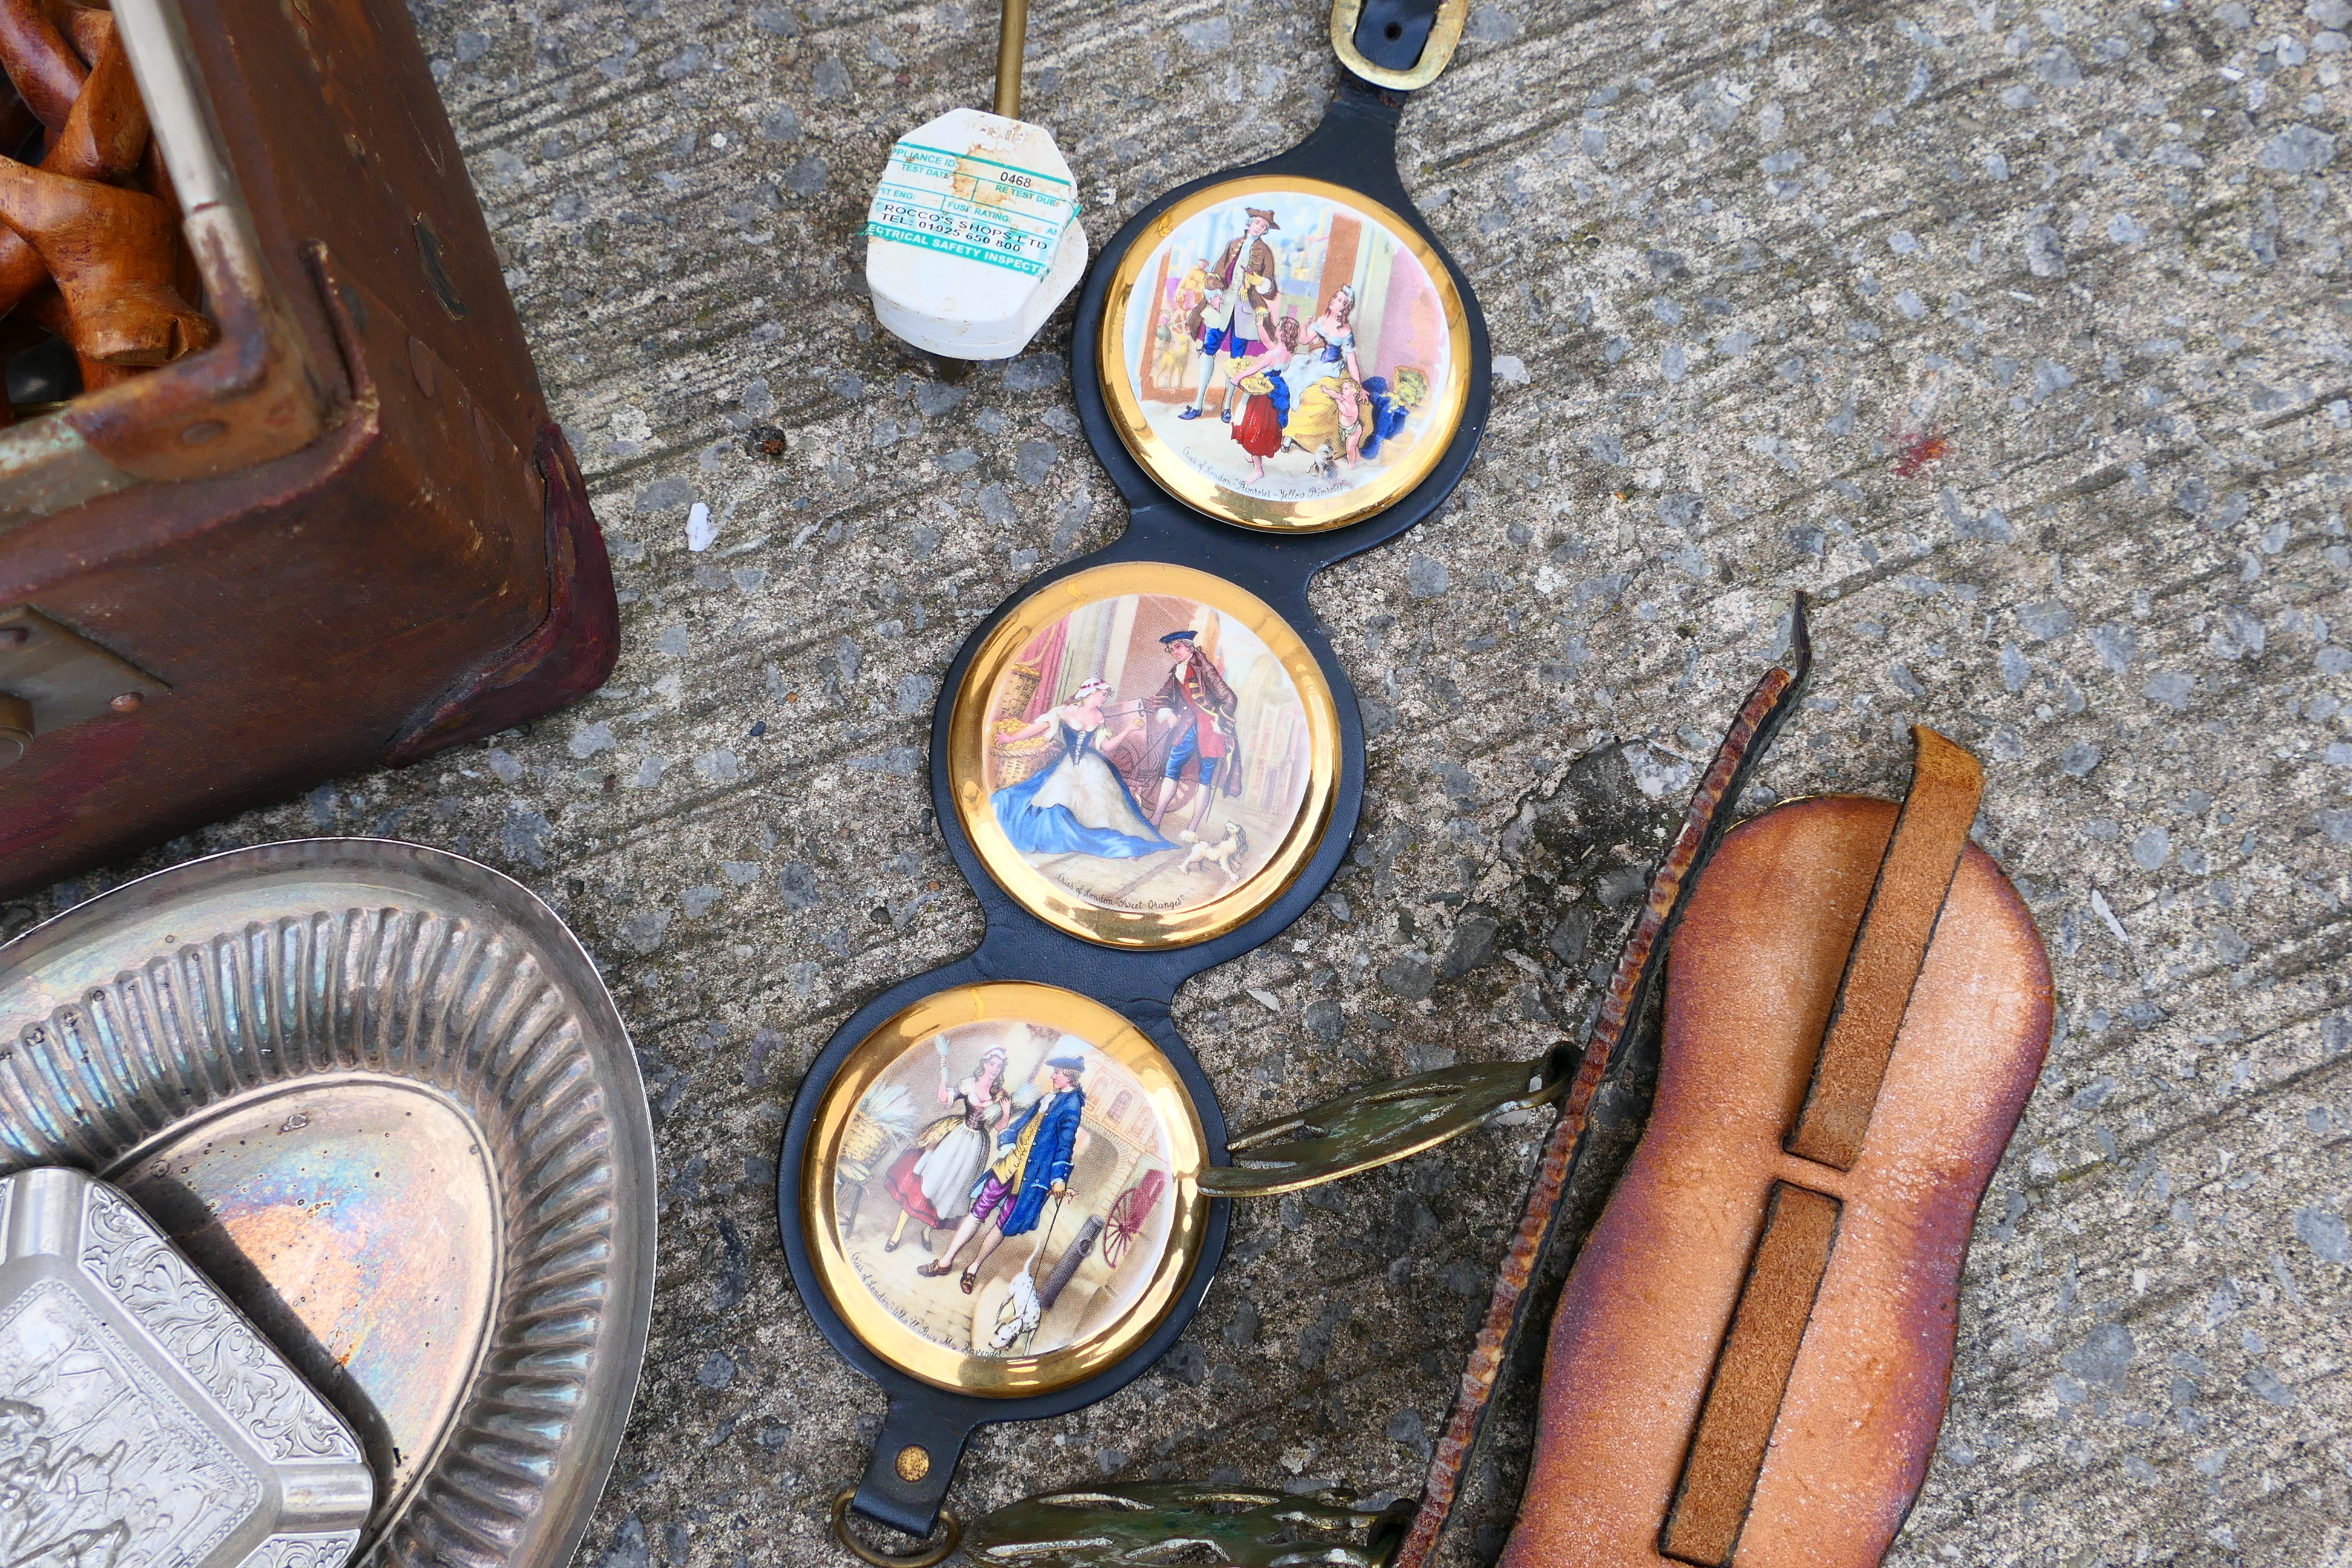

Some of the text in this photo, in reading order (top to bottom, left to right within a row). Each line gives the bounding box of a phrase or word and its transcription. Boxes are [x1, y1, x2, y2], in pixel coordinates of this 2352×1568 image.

[902, 164, 924, 173] TEST
[1001, 172, 1031, 188] 0468
[893, 189, 916, 200] ENG:
[995, 185, 1008, 194] RE
[1011, 188, 1034, 200] TEST
[884, 204, 953, 226] ROCCO'S
[958, 221, 1011, 240] SHOPS
[975, 207, 1011, 223] RATING:
[881, 212, 1021, 252] TEL: 01925 650 800
[932, 239, 981, 257] SAFETY
[1198, 462, 1207, 474] of
[1204, 465, 1231, 485] London
[1279, 489, 1305, 501] Yellow
[1076, 884, 1085, 898] of
[1084, 889, 1114, 905] London
[918, 1325, 937, 1342] Buy
[940, 1336, 957, 1350] My
